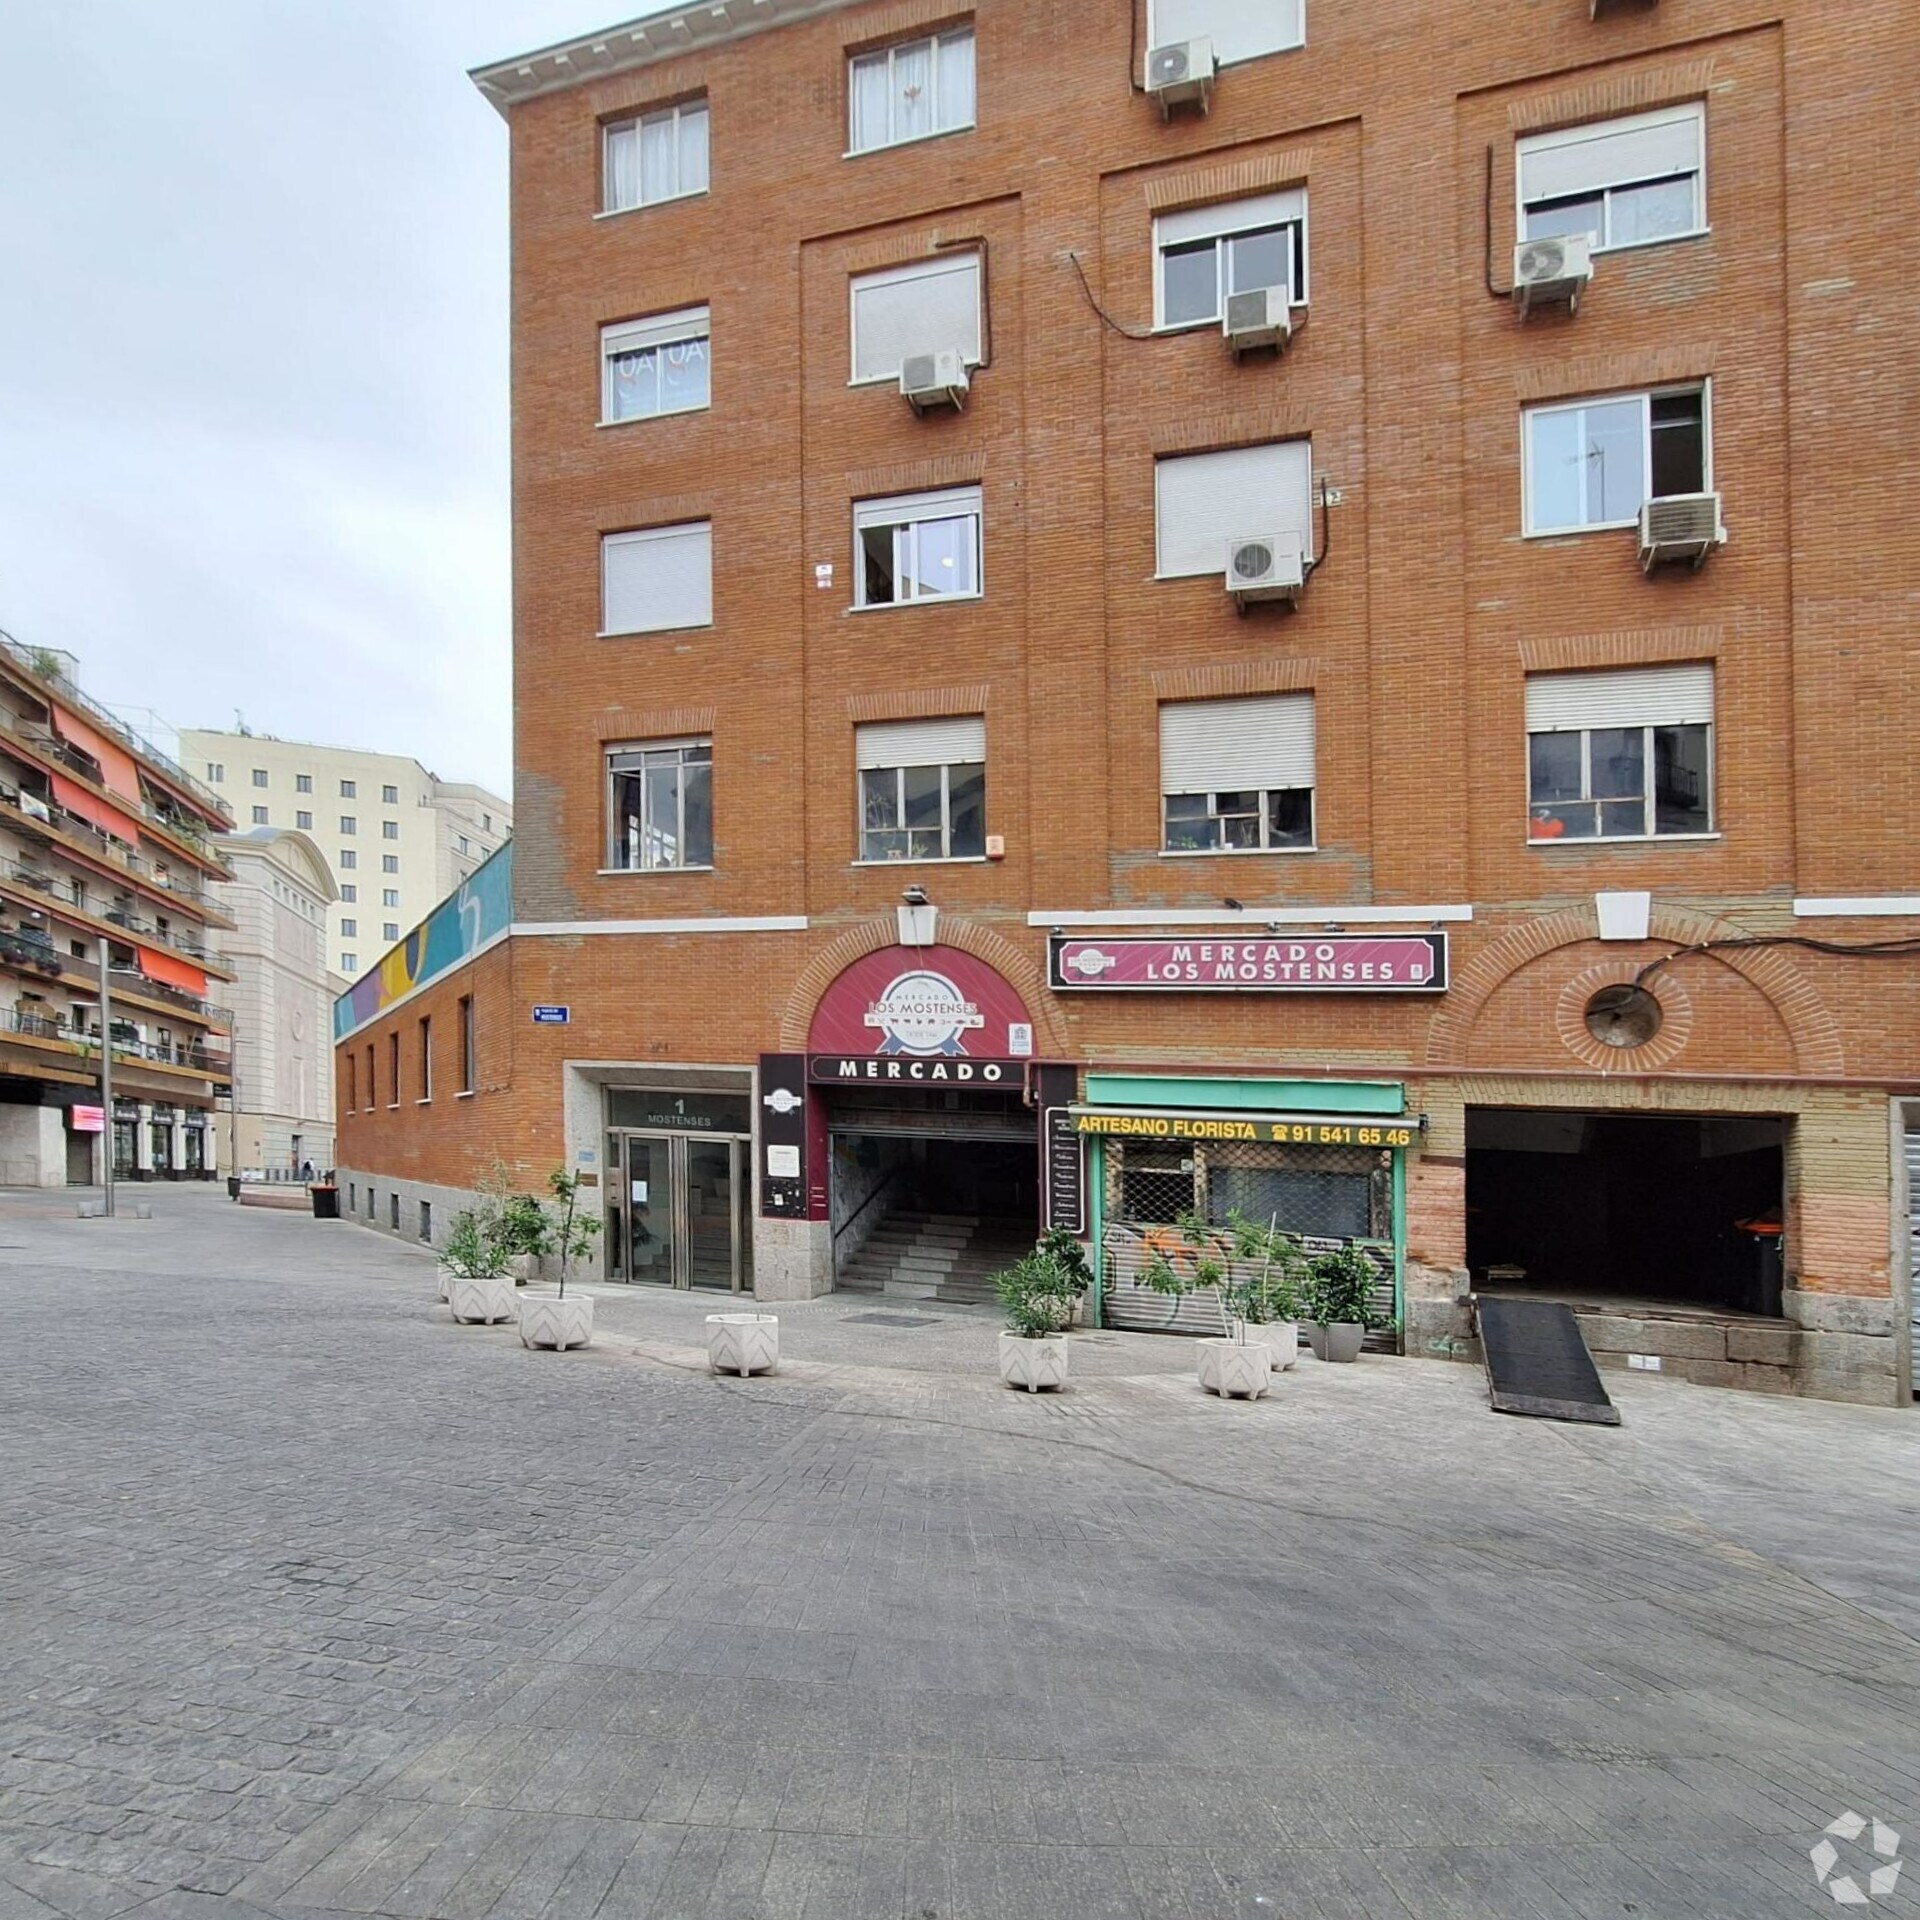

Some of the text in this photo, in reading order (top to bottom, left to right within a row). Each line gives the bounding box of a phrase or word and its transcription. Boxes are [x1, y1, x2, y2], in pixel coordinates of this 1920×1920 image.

[1172, 944, 1335, 961] MERCADO
[1147, 962, 1394, 980] LOS MOSTENSES
[868, 1001, 978, 1015] LOS MOSTENSES
[839, 1060, 1002, 1081] MERCADO
[675, 1099, 685, 1115] 1
[648, 1114, 711, 1127] MOSTENSES
[1078, 1115, 1168, 1135] ARTESANO
[1173, 1120, 1257, 1140] FLORISTA
[1292, 1125, 1312, 1142] 91
[1319, 1126, 1351, 1144] 541
[1358, 1128, 1381, 1145] 65
[1386, 1129, 1410, 1146] 46
